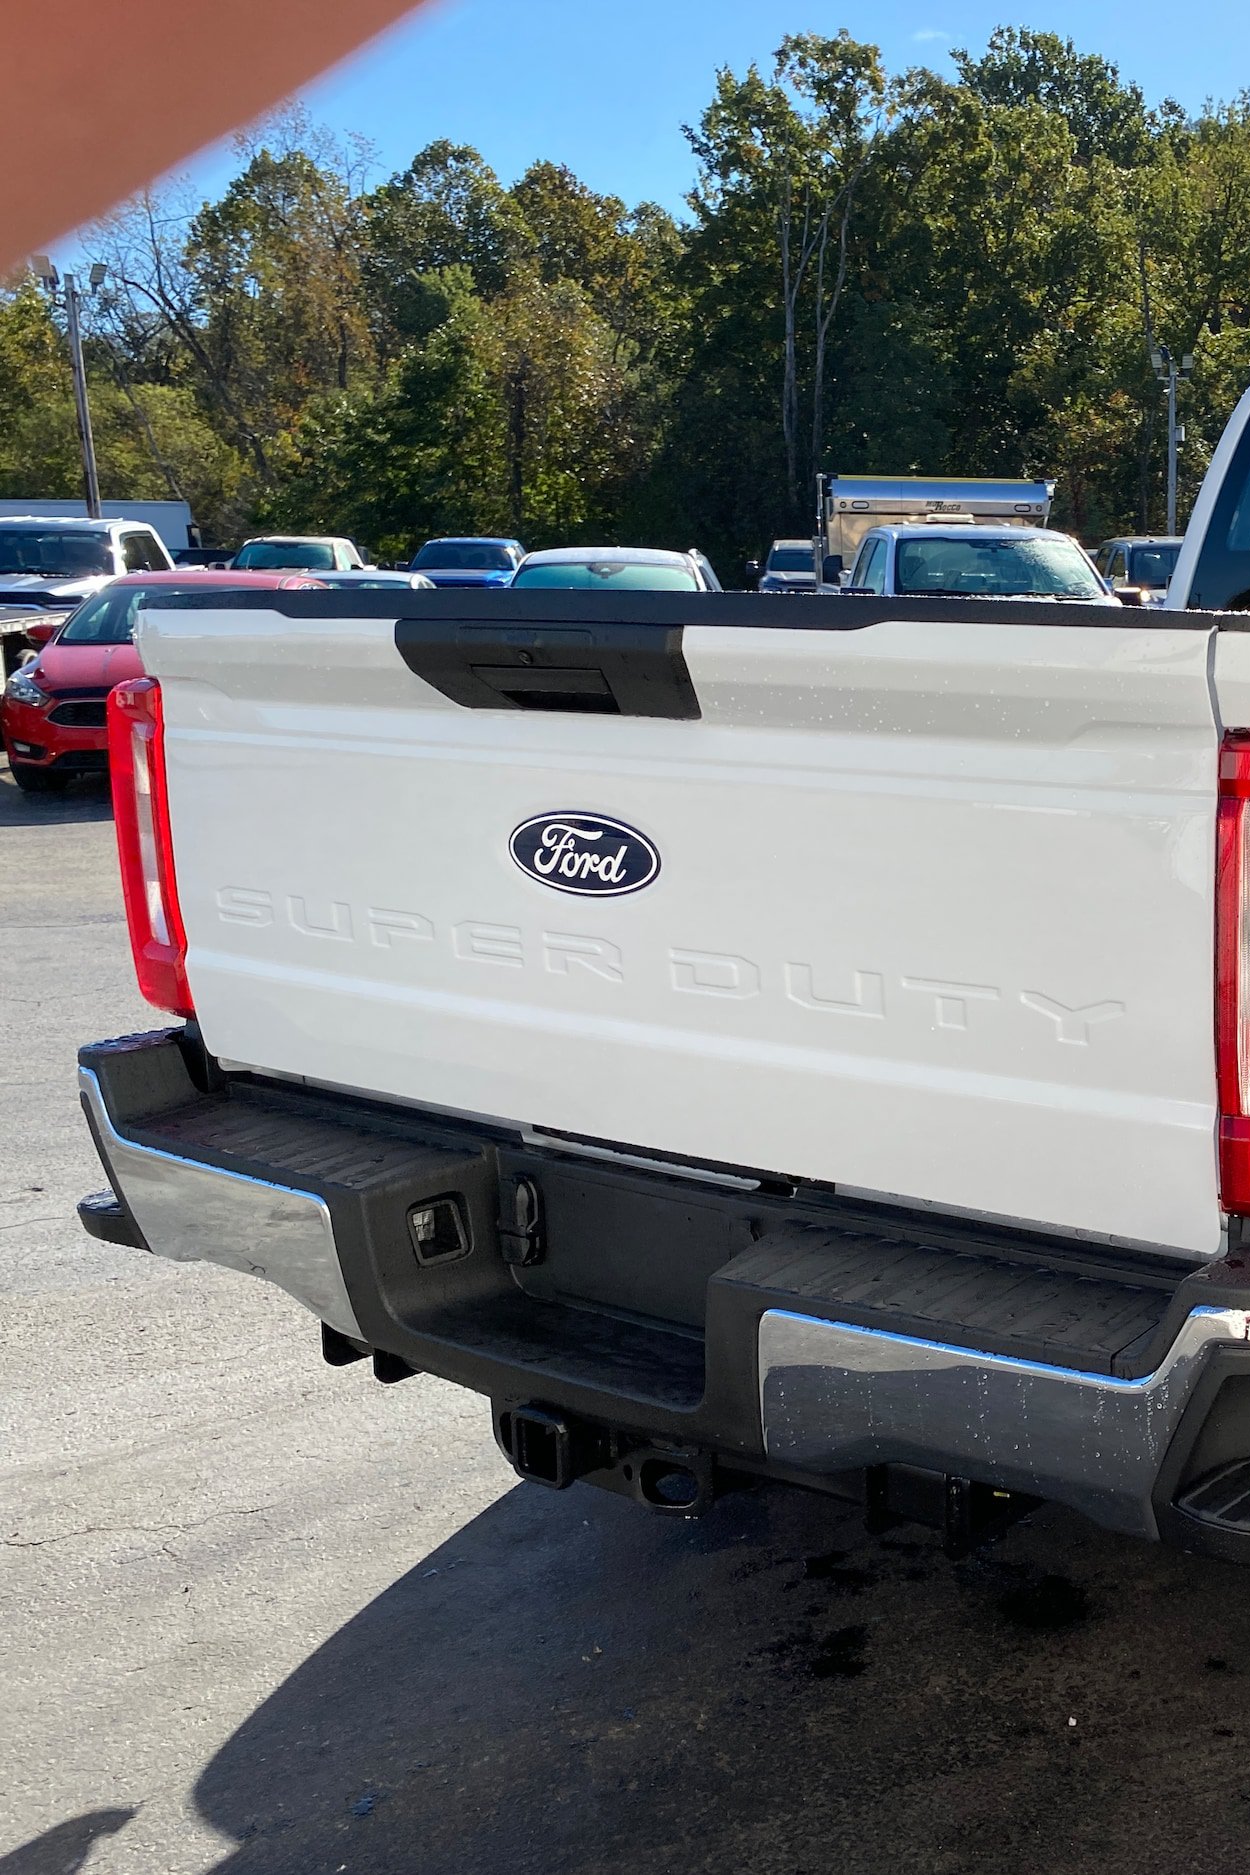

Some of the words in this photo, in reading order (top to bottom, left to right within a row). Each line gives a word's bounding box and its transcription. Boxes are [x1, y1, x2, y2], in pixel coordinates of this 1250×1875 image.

[533, 823, 629, 884] Ford
[216, 885, 624, 984] SUPER
[669, 947, 1127, 1047] DUTY
